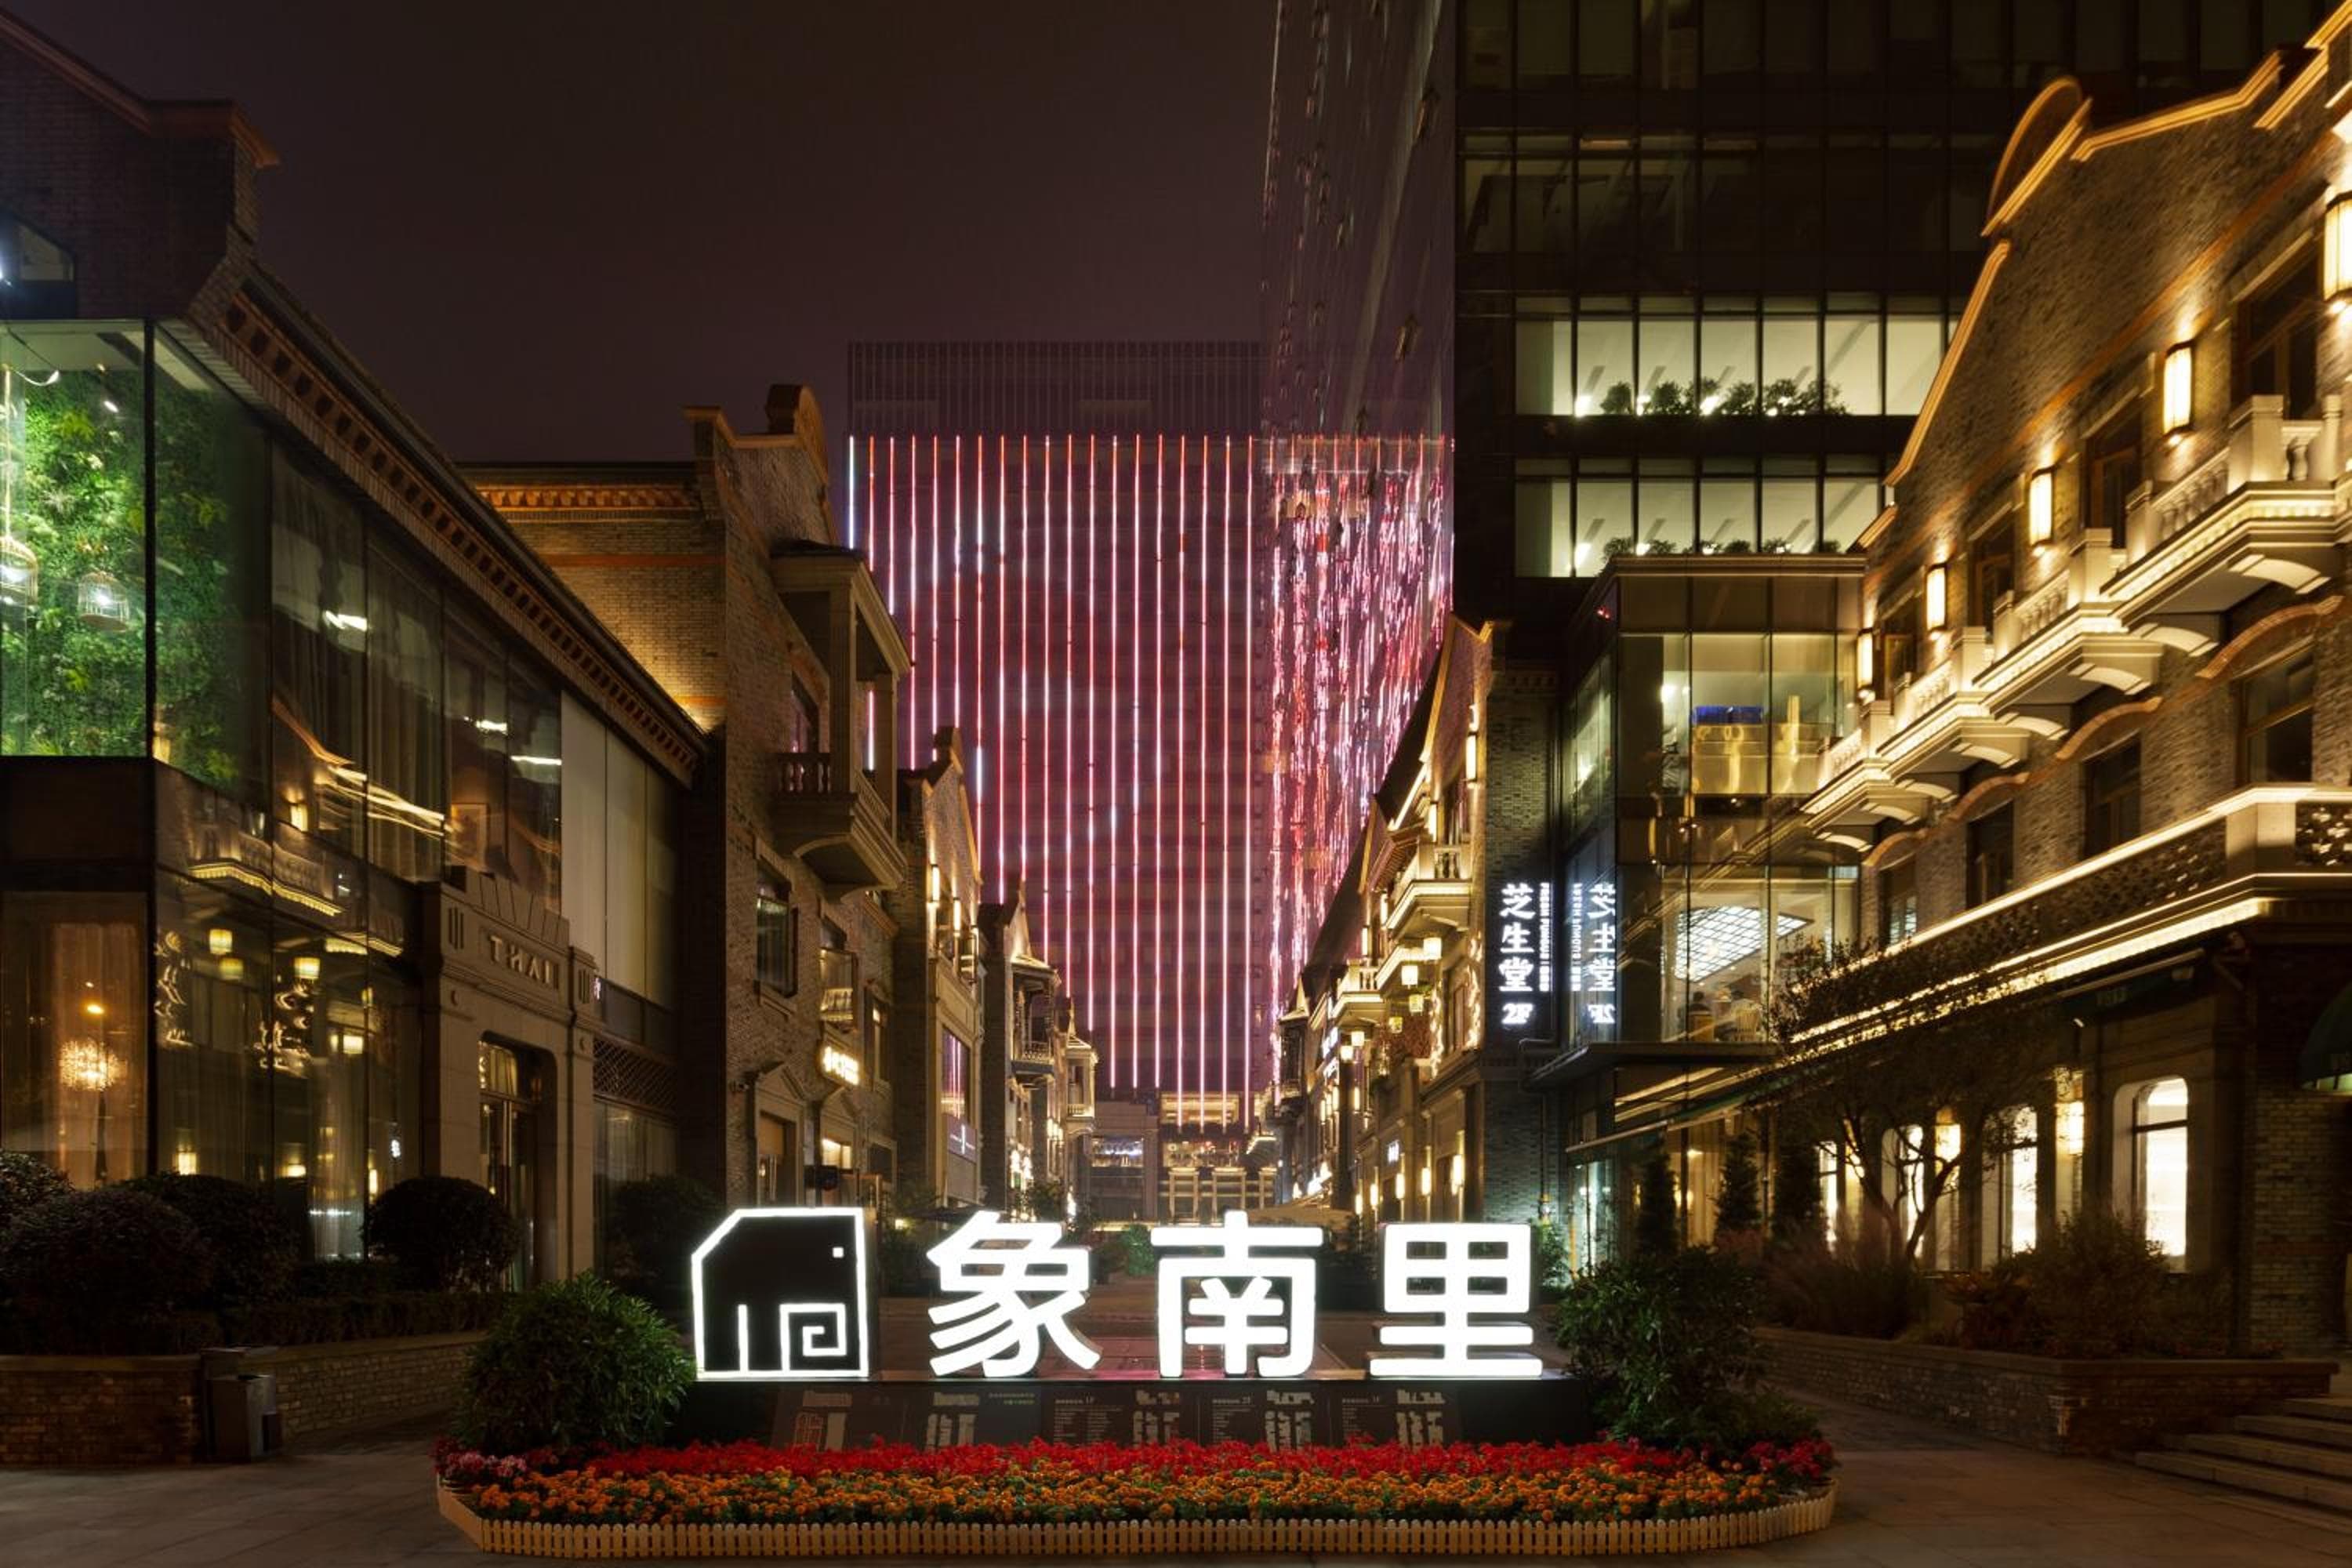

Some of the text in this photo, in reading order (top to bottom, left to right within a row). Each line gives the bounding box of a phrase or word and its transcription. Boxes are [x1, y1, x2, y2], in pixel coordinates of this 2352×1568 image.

[1499, 884, 1535, 1024] 芝生堂 2F
[927, 1210, 1543, 1377] 象南里
